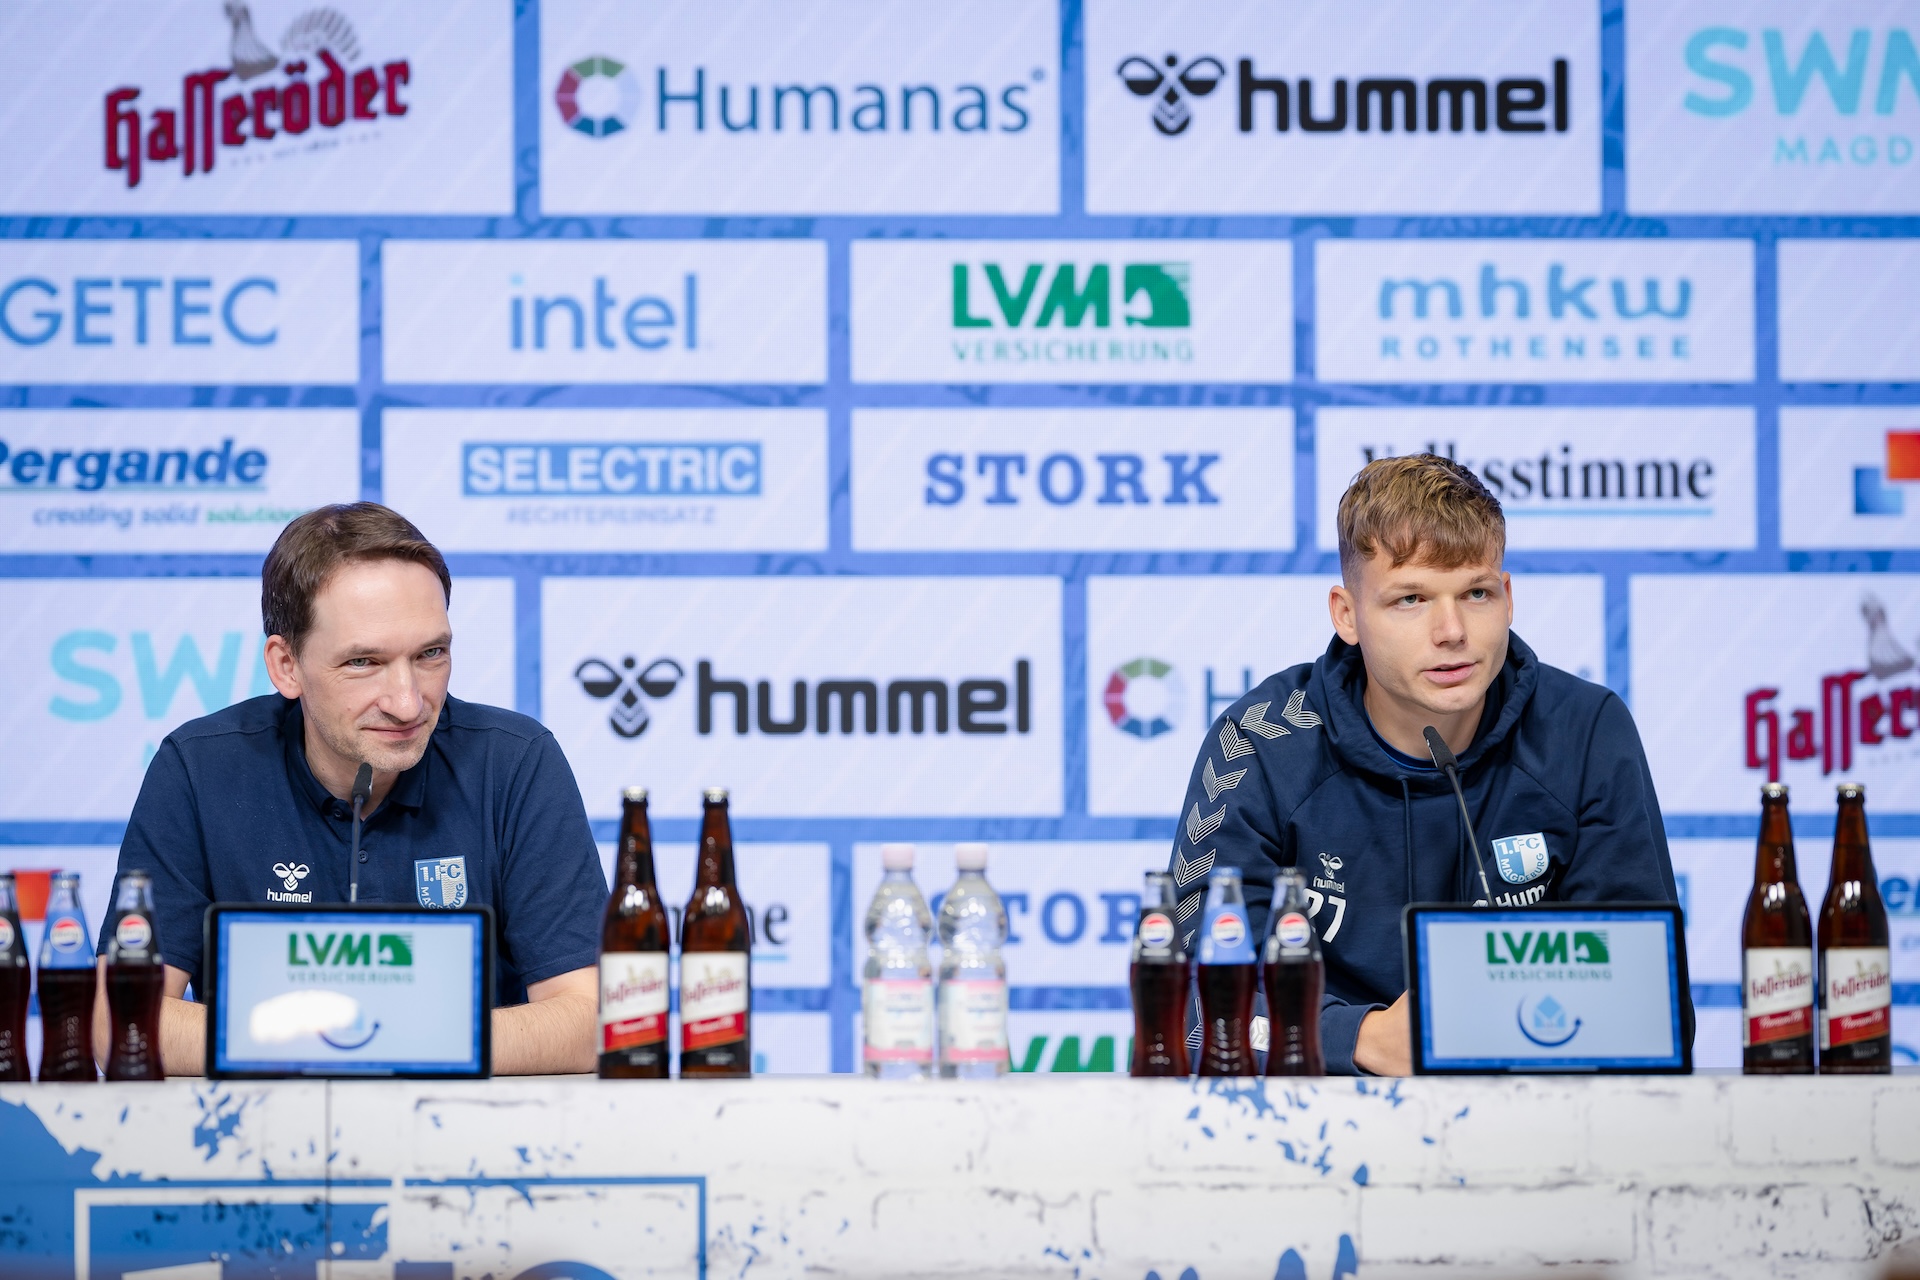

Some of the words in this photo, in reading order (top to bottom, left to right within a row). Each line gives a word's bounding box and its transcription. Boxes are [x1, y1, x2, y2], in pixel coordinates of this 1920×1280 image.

[656, 66, 1031, 133] Humanas
[1237, 56, 1571, 134] hummel
[0, 277, 279, 347] GETEC
[510, 272, 698, 351] intel
[952, 263, 1111, 329] LVM
[1378, 262, 1694, 320] mhkw
[953, 340, 1194, 363] VERSICHERUNG
[1380, 336, 1690, 359] ROTHENSEE
[466, 446, 757, 493] SELECTRIC
[924, 453, 1221, 507] STORK
[33, 503, 132, 528] creating
[142, 502, 200, 524] solid
[48, 627, 272, 724] SW
[695, 658, 1031, 736] hummel
[1501, 852, 1545, 883] MAGDEBURG
[266, 888, 312, 904] hummel
[288, 933, 372, 966] LVM
[1485, 931, 1569, 965] LVM
[1487, 968, 1613, 981] VERSICHERUNG
